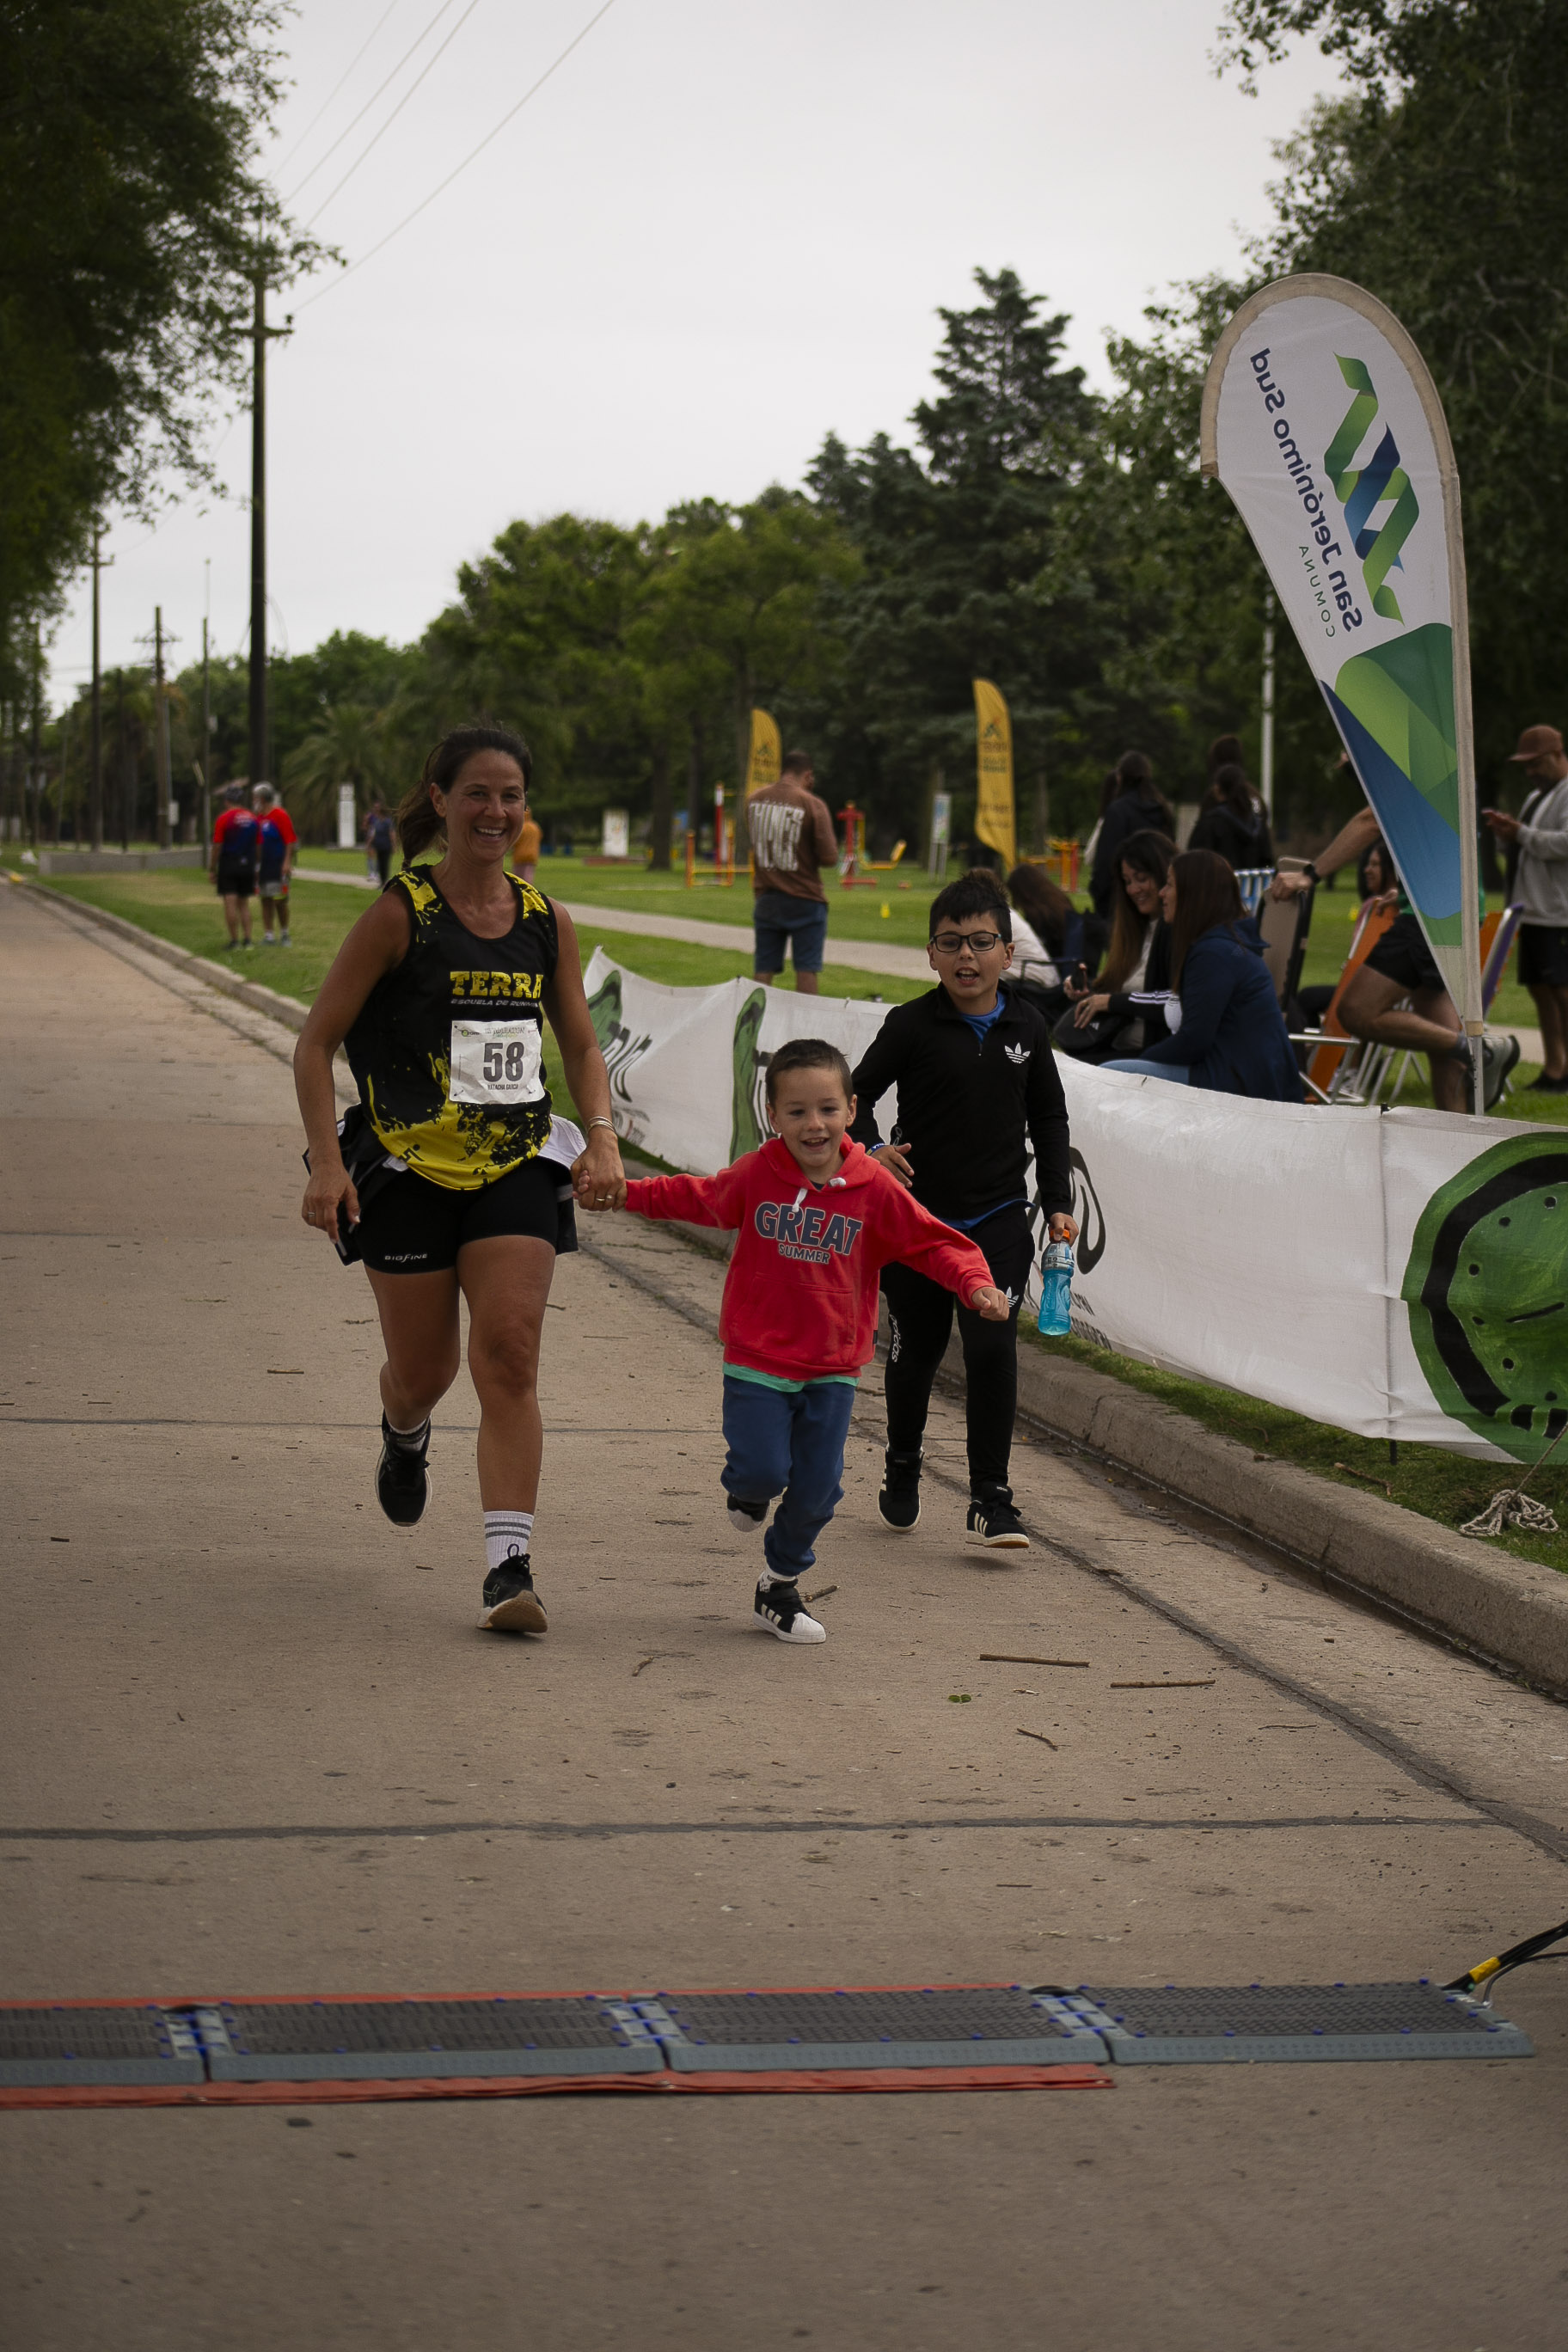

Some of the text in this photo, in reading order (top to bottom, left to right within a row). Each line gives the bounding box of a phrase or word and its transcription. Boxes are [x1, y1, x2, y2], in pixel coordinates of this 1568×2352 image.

[482, 1041, 525, 1083] 58
[754, 1201, 864, 1256] GREAT
[778, 1243, 831, 1265] SUMMER
[888, 1314, 902, 1363] adidas
